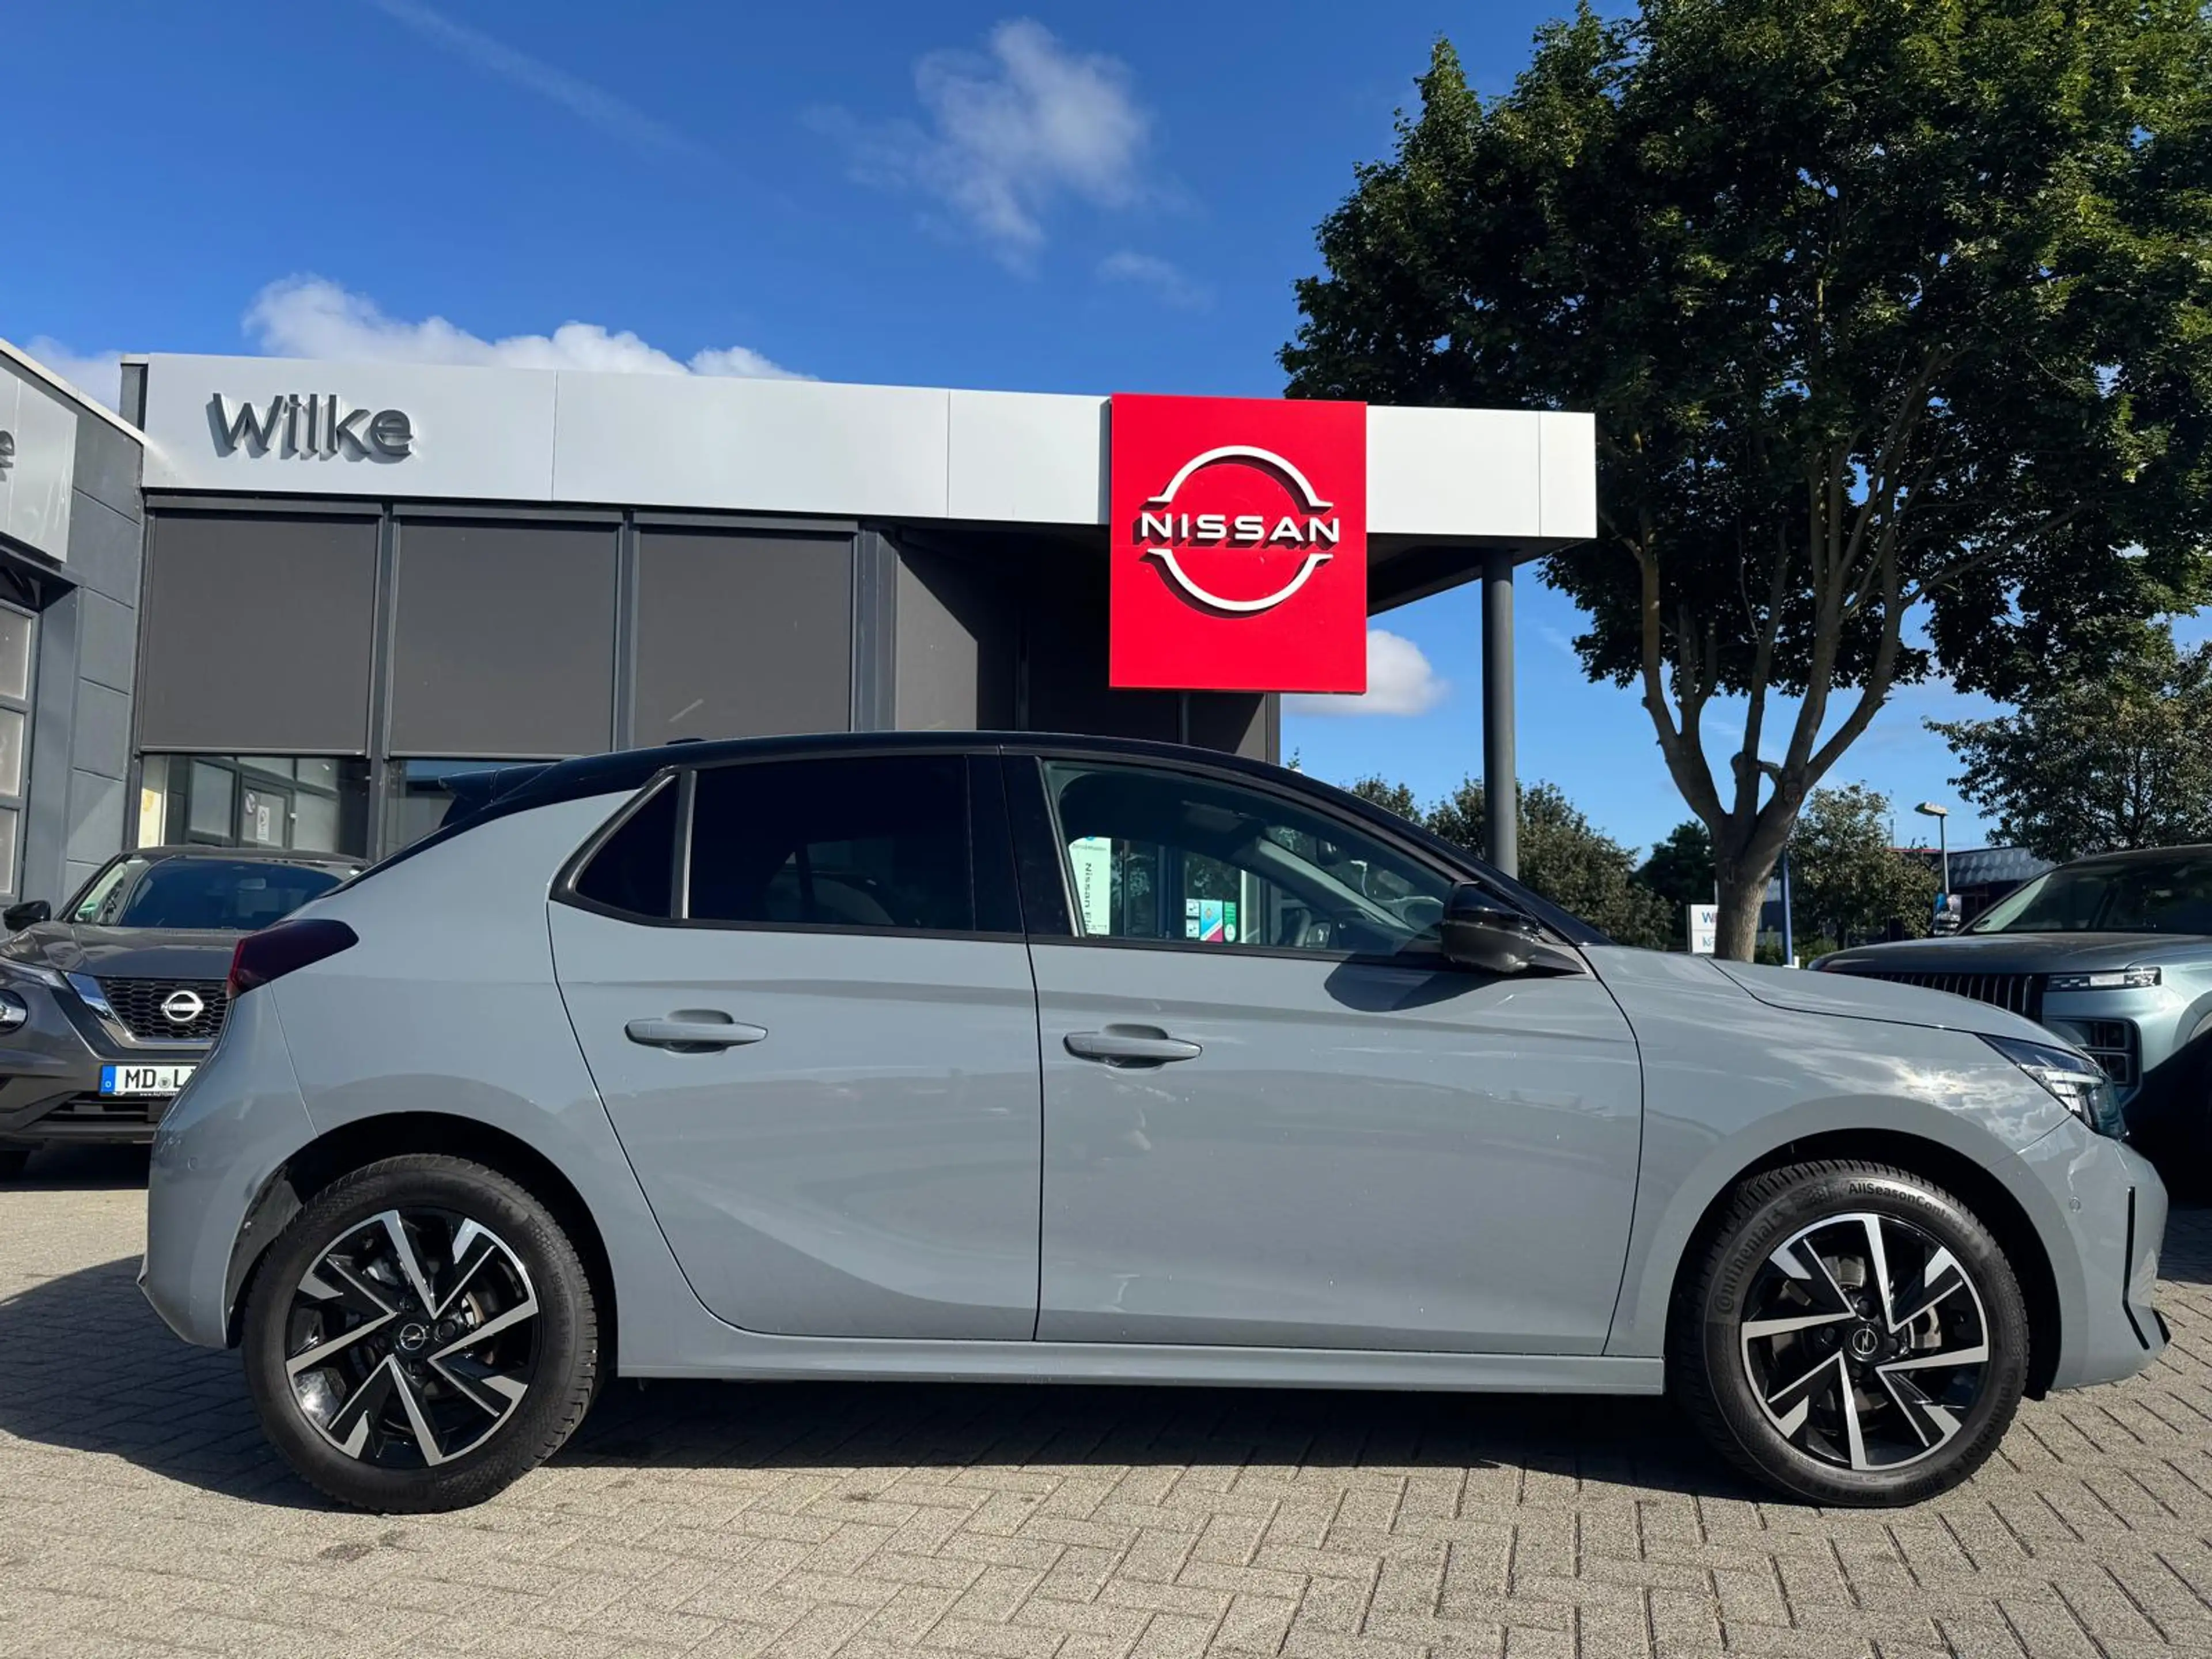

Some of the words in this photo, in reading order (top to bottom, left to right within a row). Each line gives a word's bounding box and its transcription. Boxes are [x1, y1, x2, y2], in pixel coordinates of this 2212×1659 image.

[212, 393, 413, 456] Wilke
[1141, 512, 1339, 542] NISSAN
[1084, 862, 1092, 908] Nissan
[124, 1069, 157, 1089] MD
